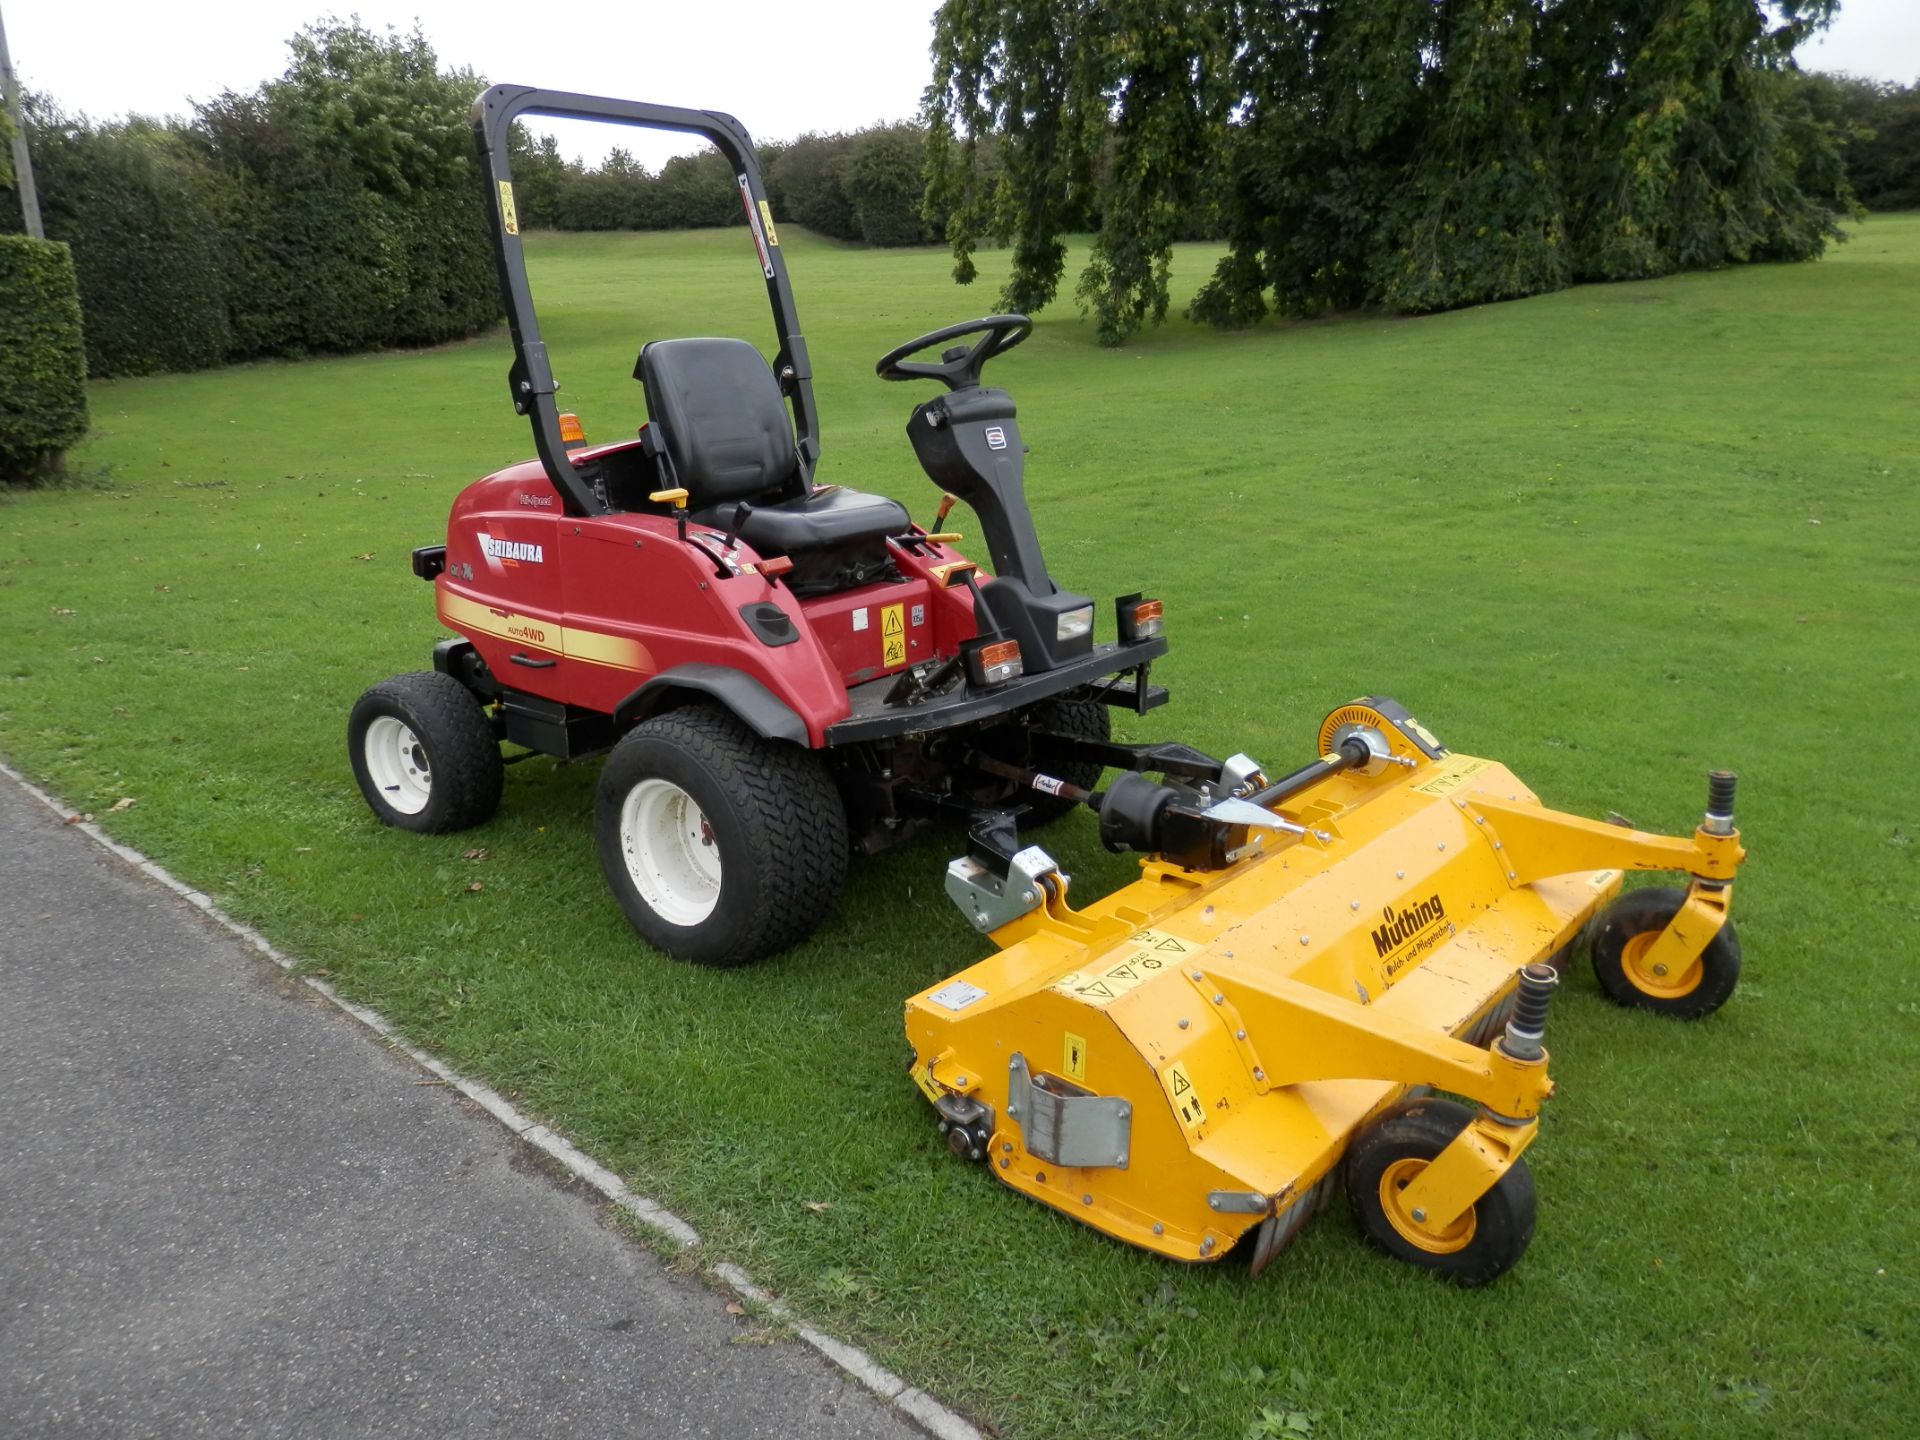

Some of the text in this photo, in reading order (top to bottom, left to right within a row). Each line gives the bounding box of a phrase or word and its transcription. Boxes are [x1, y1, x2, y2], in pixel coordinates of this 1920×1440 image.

[520, 494, 553, 507] Hi-Speed
[488, 537, 544, 563] SHIBAURA
[1371, 894, 1444, 958] Müthing
[1405, 948, 1417, 962] und
